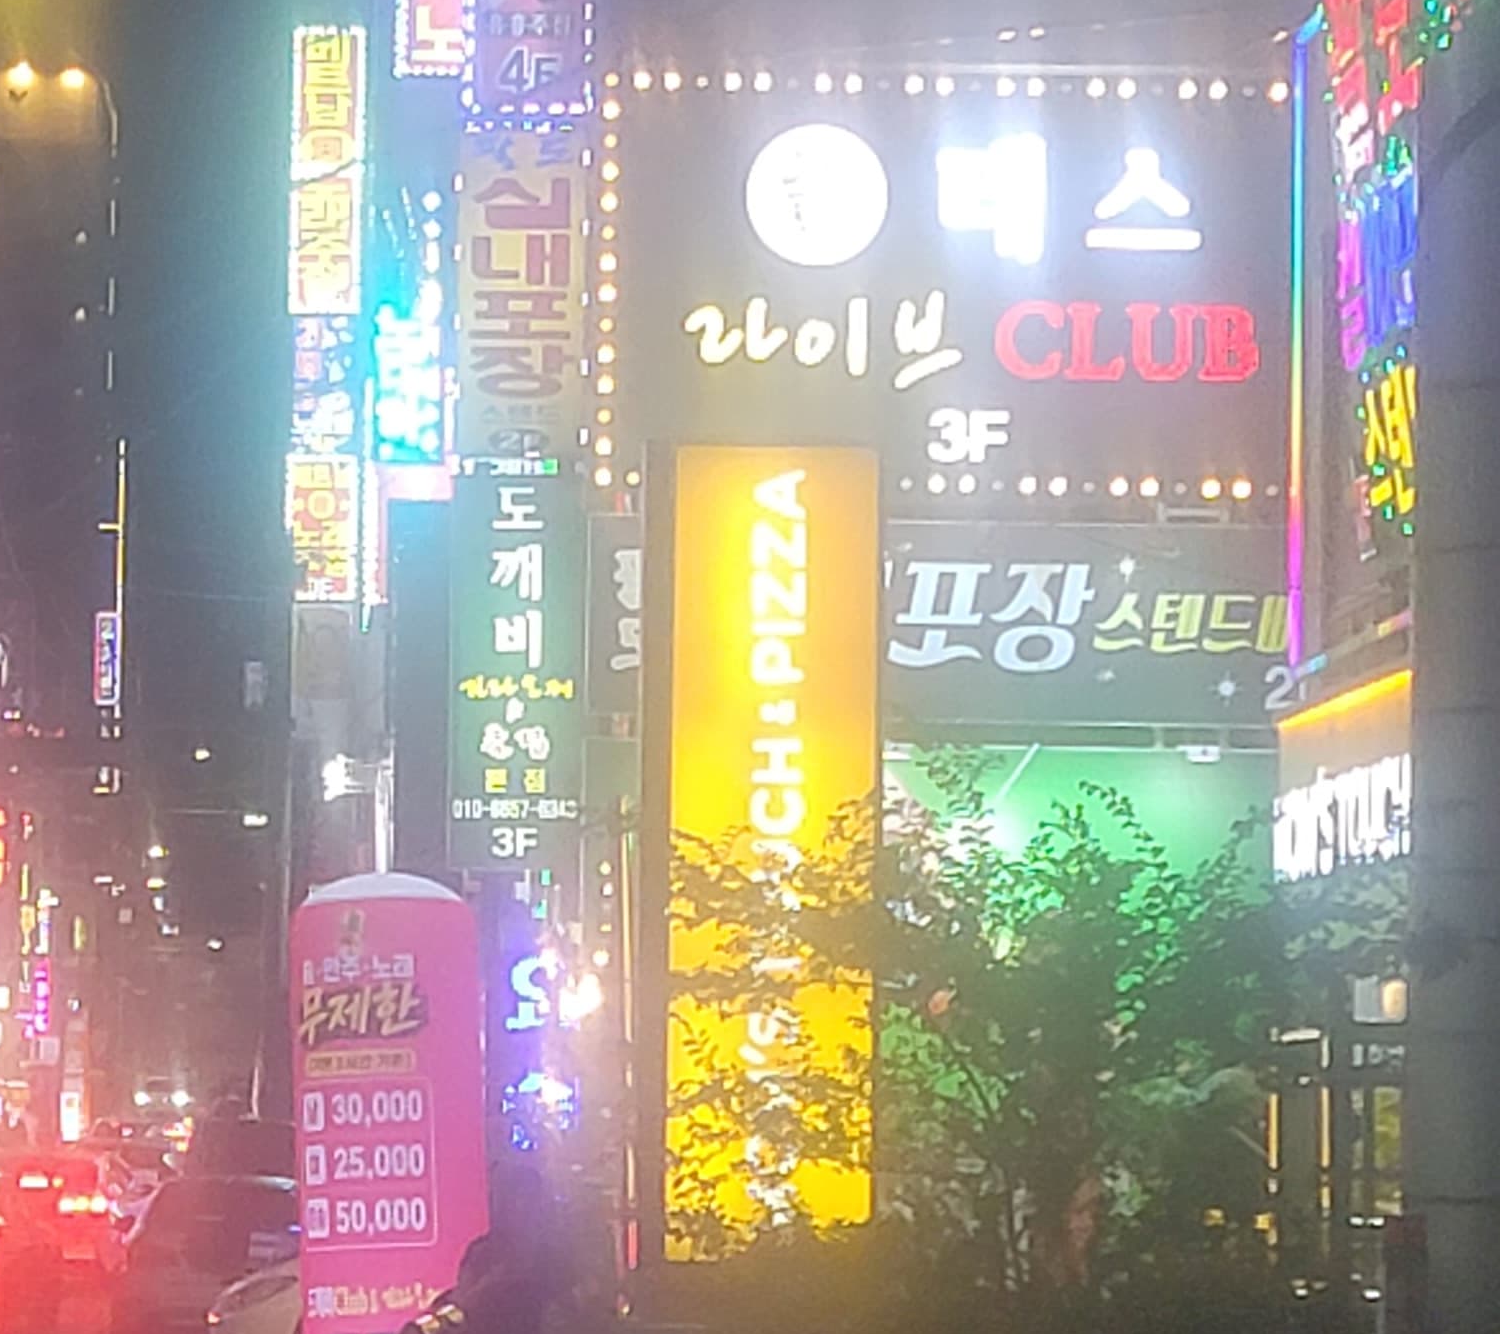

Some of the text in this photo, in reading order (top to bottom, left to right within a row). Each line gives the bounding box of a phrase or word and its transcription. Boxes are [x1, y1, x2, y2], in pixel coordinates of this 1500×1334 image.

[994, 299, 1260, 381] CLUB
[927, 408, 1011, 464] 3F
[490, 485, 544, 669] 도깨비
[751, 469, 807, 686] PIZZA
[886, 560, 1097, 675] 포장
[491, 827, 539, 858] 3F
[299, 981, 422, 1046] 무제한
[331, 1089, 424, 1128] 30,000
[333, 1143, 426, 1181] 25,000
[335, 1196, 428, 1237] 50,000
